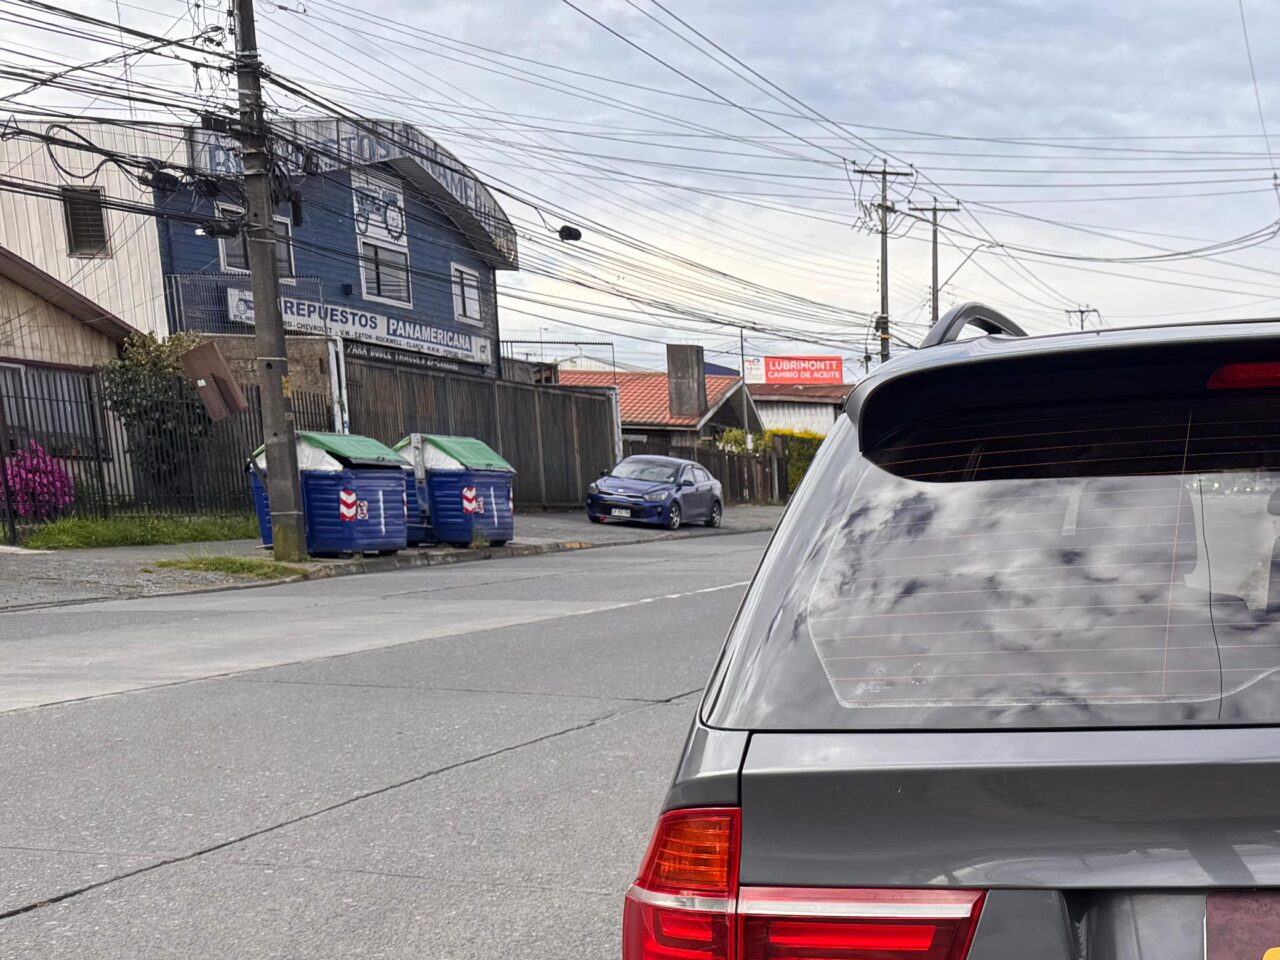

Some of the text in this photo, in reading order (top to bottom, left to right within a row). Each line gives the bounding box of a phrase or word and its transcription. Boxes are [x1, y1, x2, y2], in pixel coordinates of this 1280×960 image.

[284, 299, 471, 351] REPUESTOS PANAMERICANA
[769, 360, 838, 370] LUBRIMONTT
[768, 371, 840, 379] CAMBIO DE ACEITE
